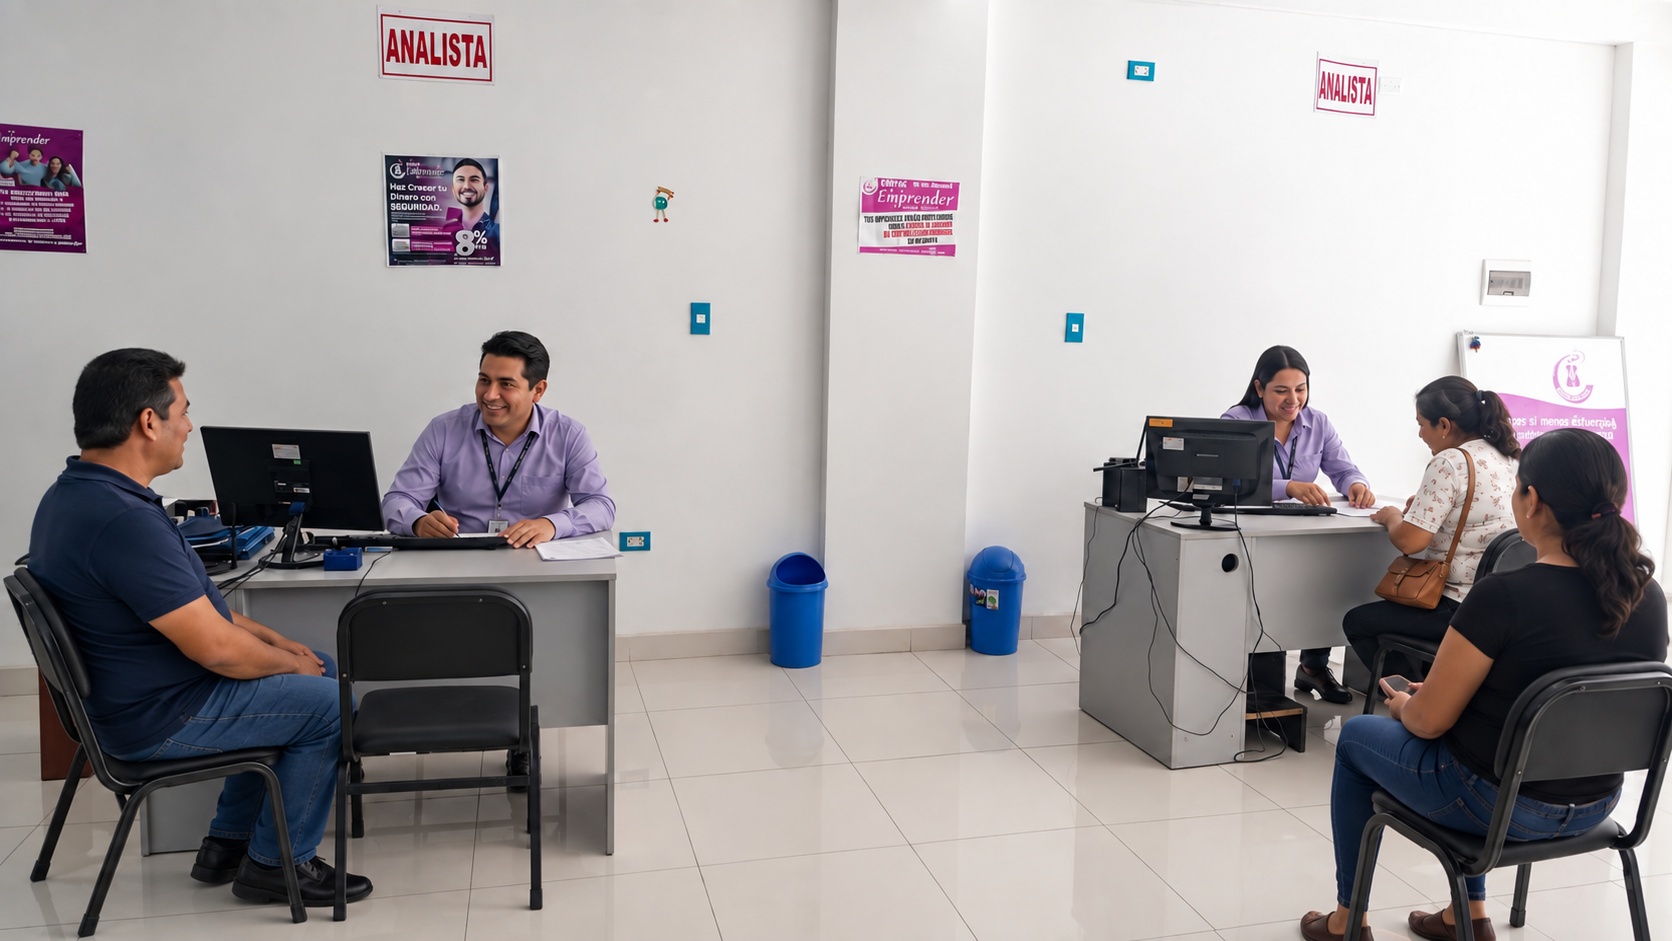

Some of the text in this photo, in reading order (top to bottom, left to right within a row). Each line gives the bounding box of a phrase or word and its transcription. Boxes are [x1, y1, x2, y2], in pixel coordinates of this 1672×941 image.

[386, 28, 488, 69] ANALISTA
[1319, 71, 1372, 105] ANALISTA
[0, 133, 50, 146] mprender
[877, 189, 954, 208] Emprender
[1529, 416, 1537, 426] si
